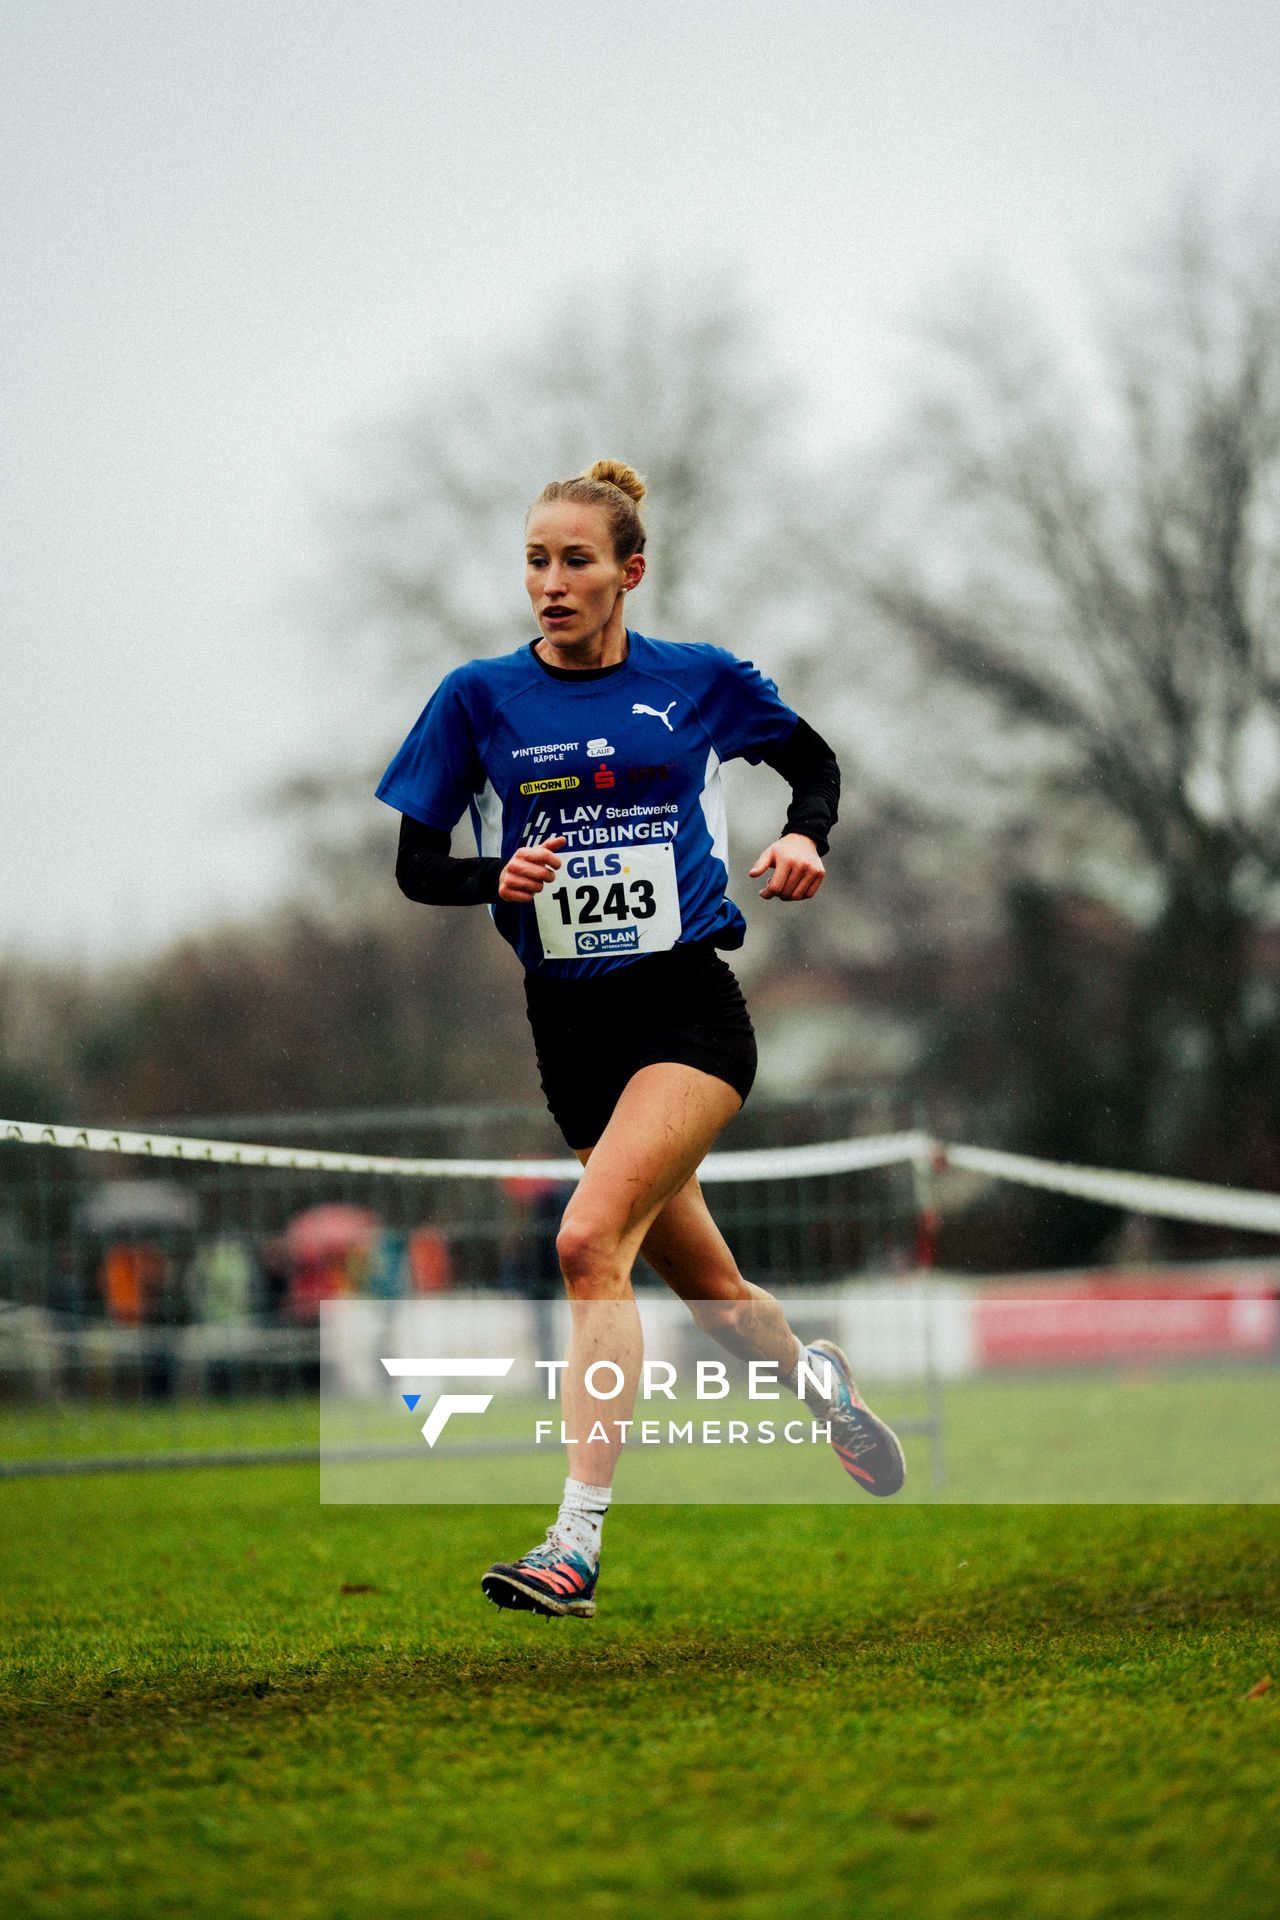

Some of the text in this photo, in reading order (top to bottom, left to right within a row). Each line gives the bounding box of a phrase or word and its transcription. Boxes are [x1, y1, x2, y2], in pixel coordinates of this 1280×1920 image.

[519, 743, 579, 757] INTERSPORT
[590, 748, 612, 756] LAUF
[533, 753, 564, 763] RÄPPLE
[534, 781, 562, 791] HORN
[559, 802, 679, 824] LAV Stadtwerke
[562, 820, 679, 847] TÜBINGEN
[552, 880, 656, 925] 1243
[600, 931, 636, 945] PLAN
